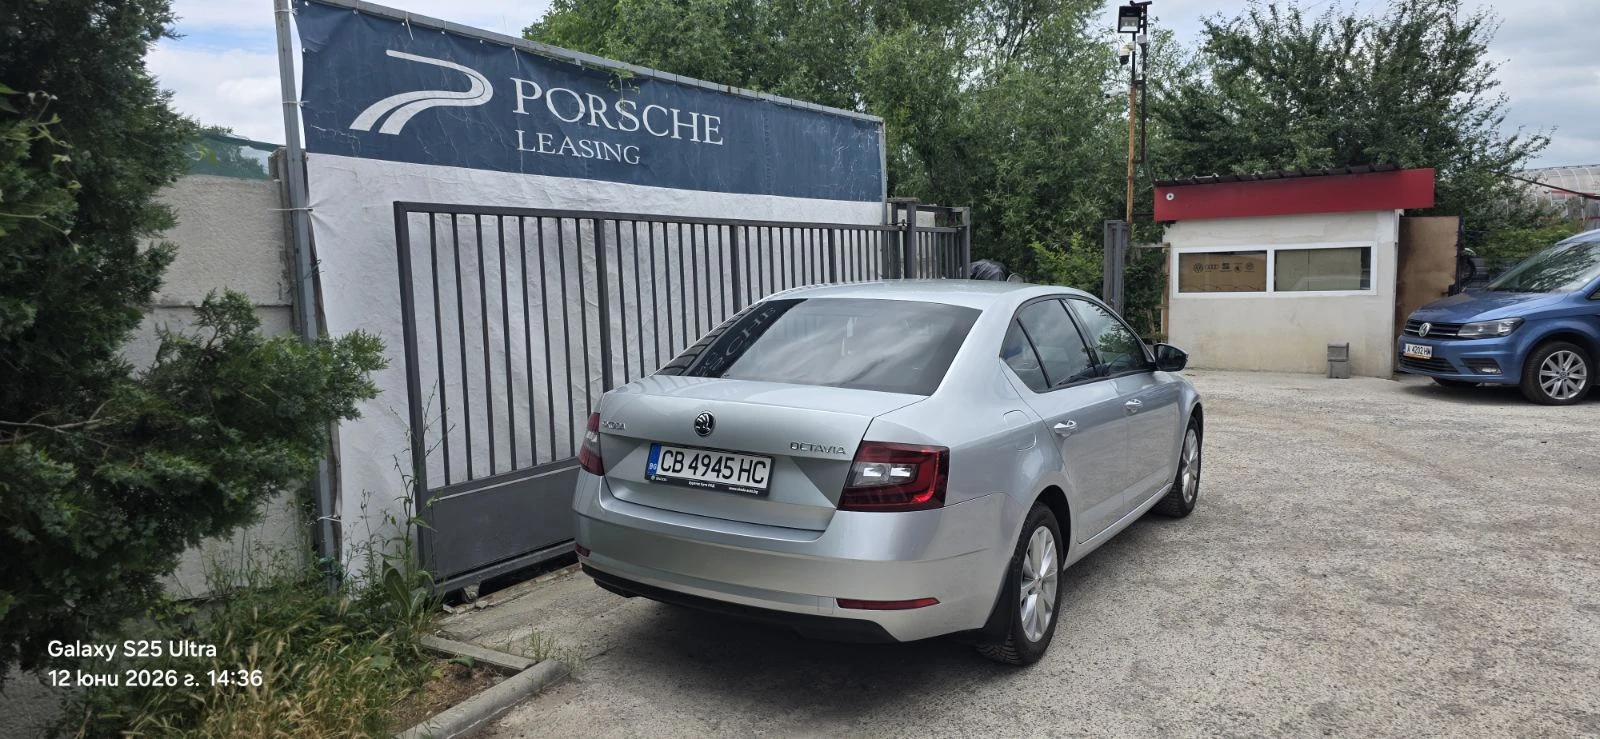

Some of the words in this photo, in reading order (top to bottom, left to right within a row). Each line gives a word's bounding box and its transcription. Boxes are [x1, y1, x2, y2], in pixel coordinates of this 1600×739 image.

[510, 77, 724, 146] PORSCHE
[516, 129, 640, 165] LEASING
[790, 442, 846, 455] OCTAVIA
[688, 453, 735, 480] 4945
